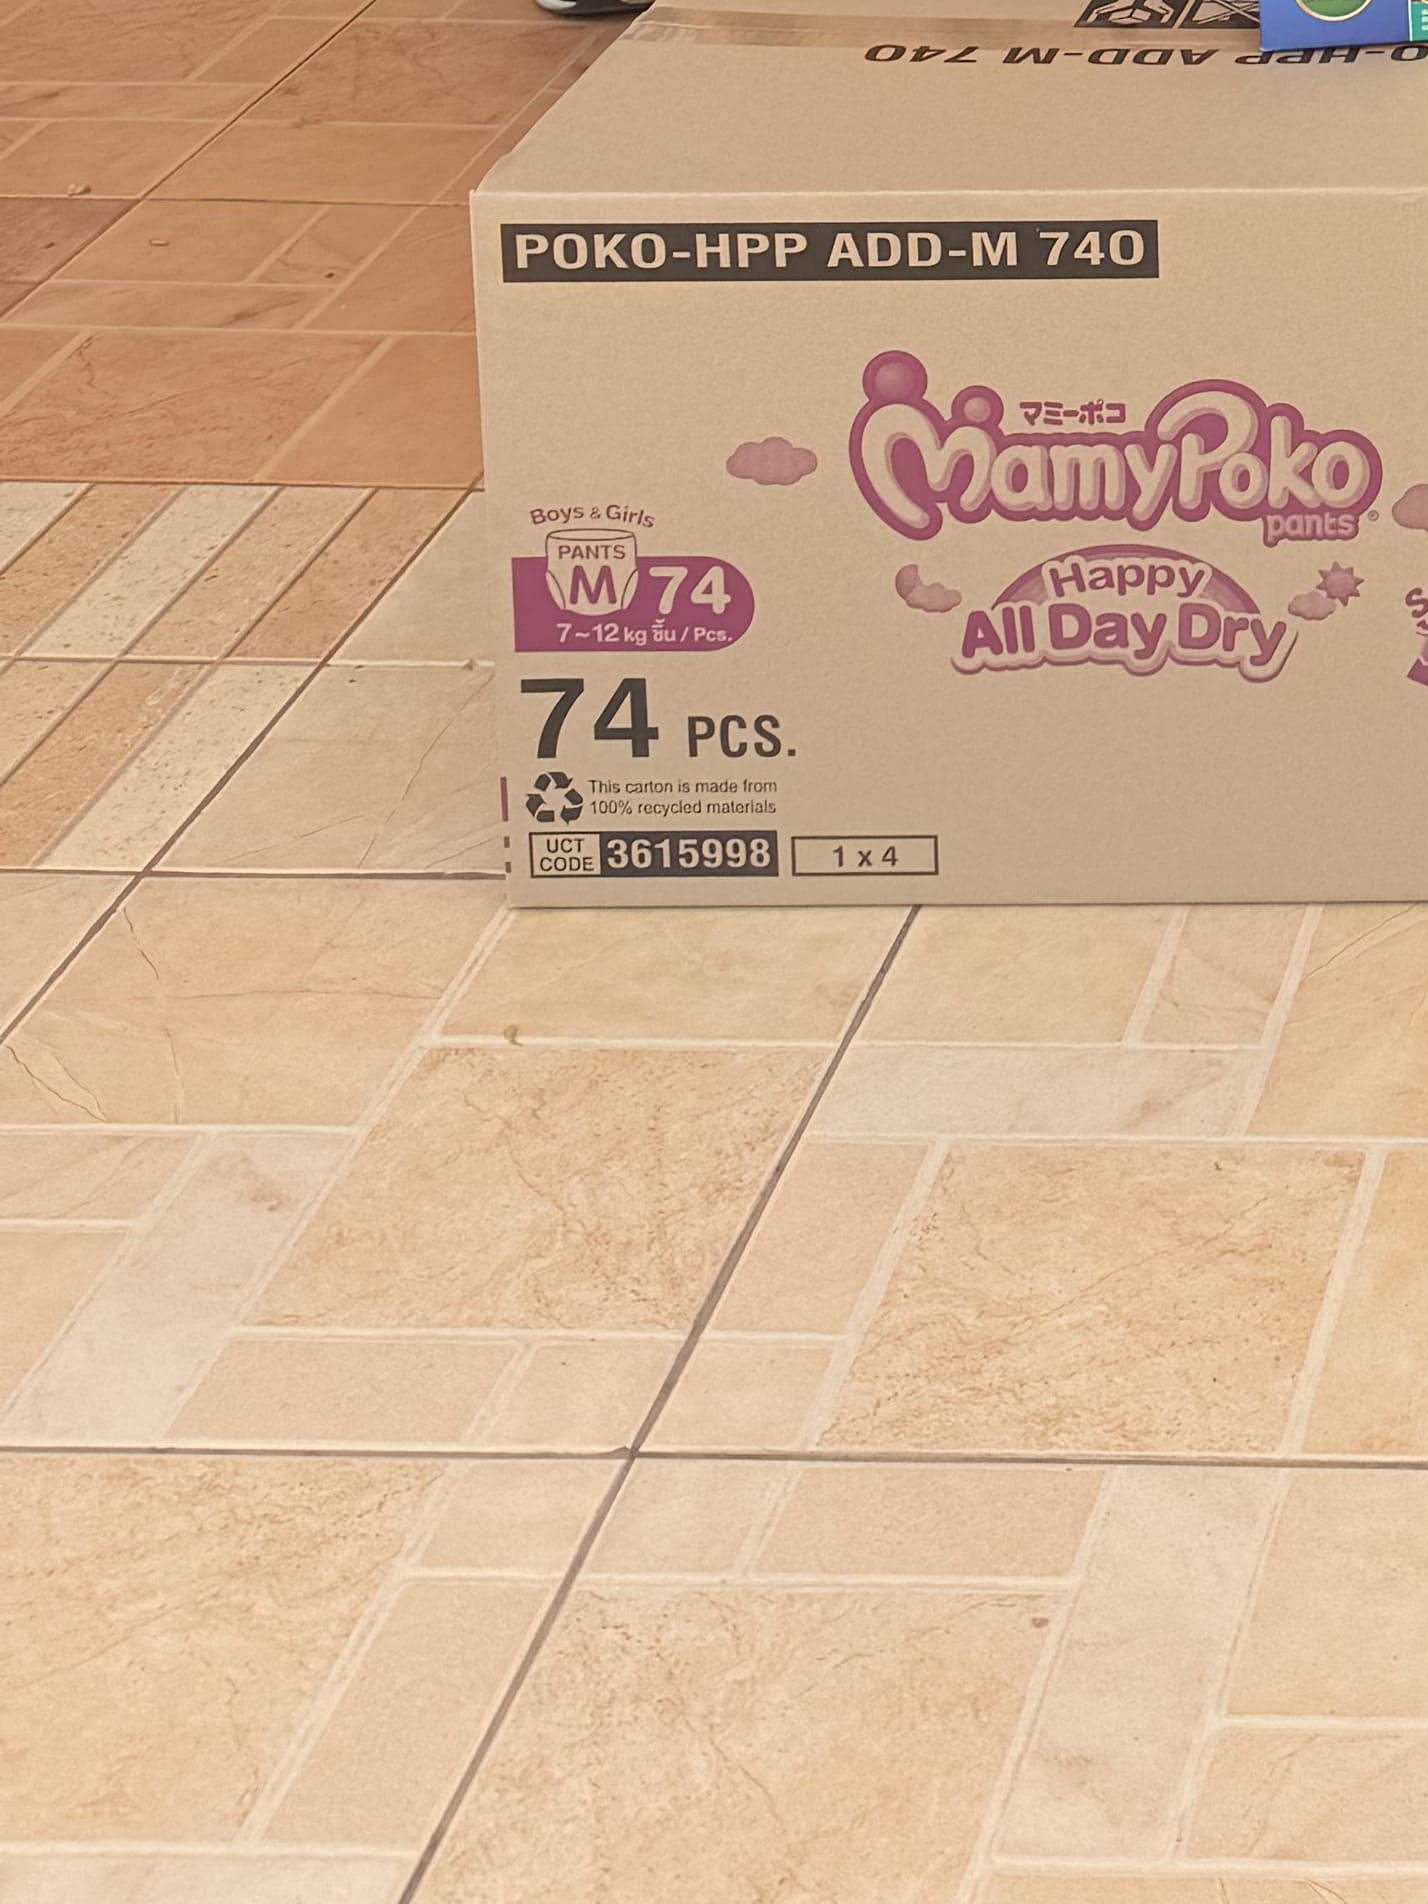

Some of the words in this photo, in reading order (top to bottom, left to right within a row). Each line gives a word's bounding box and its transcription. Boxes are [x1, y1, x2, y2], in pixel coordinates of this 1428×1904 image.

[515, 231, 810, 270] POKO-HPP
[825, 231, 1019, 269] ADD-M
[1037, 229, 1146, 268] 740
[849, 349, 1383, 541] MamyPoko
[557, 543, 626, 562] PANTS
[568, 566, 617, 606] M
[648, 566, 732, 615] 74
[519, 677, 660, 759] 74
[686, 714, 797, 758] PCS.
[587, 778, 620, 795] This
[625, 779, 673, 795] carton
[678, 779, 691, 794] is
[697, 779, 736, 794] made
[744, 778, 778, 794] from
[606, 836, 772, 870] 3615998
